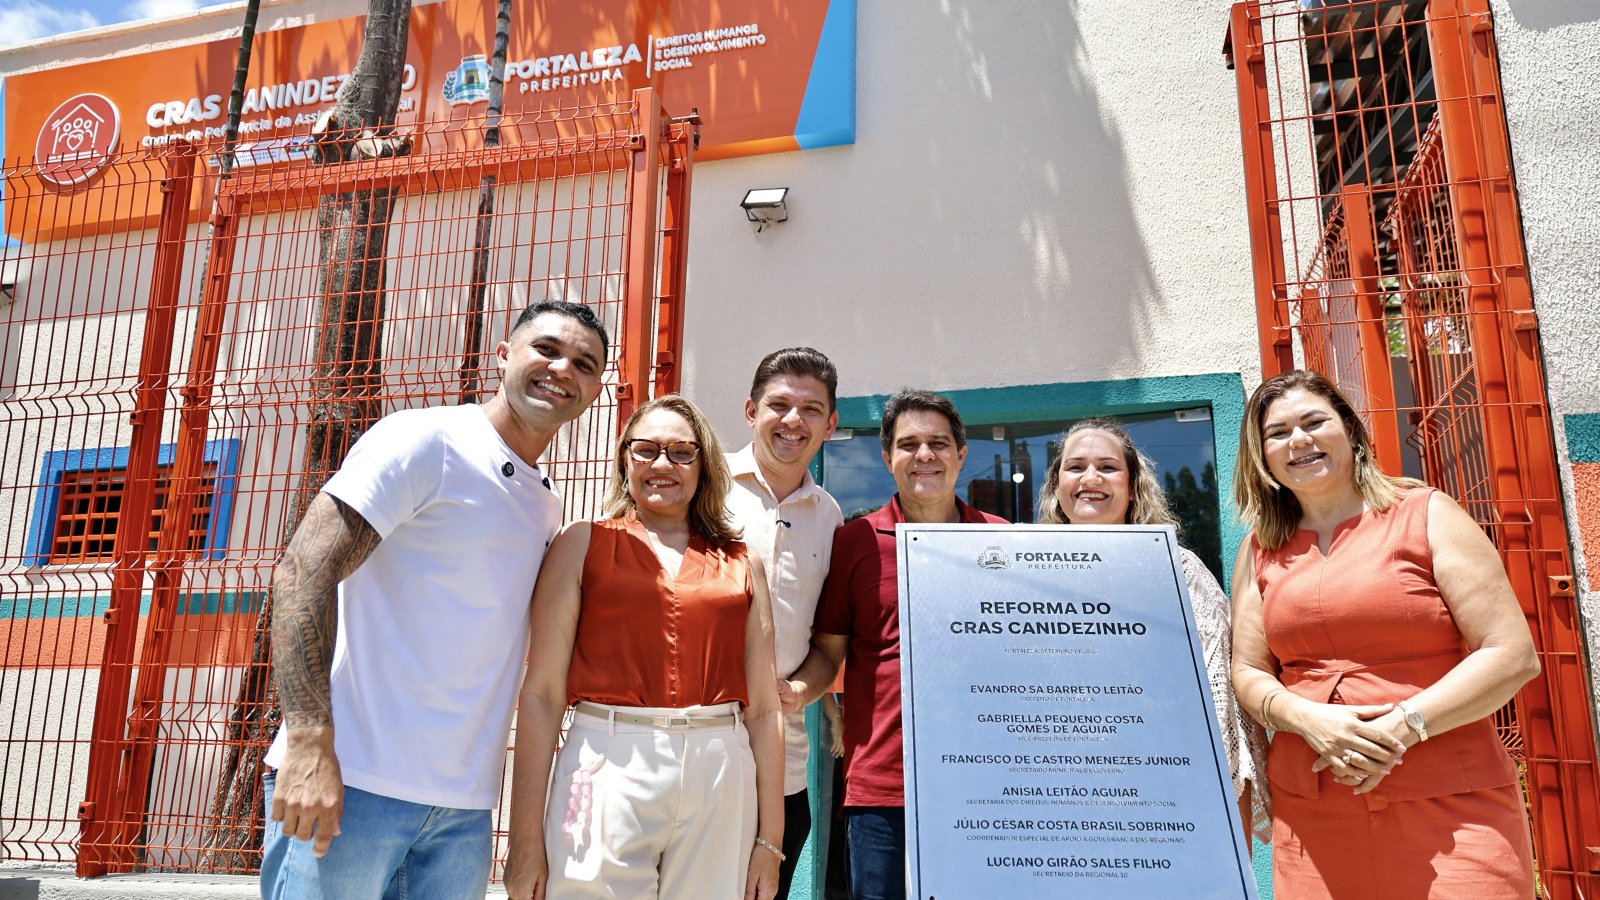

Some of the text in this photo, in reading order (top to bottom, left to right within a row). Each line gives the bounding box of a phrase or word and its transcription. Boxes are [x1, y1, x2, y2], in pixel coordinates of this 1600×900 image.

[656, 24, 758, 48] DIREITOS HUMANOS
[655, 34, 766, 59] E DESENVOLVIMENTO
[504, 43, 642, 82] FORTALEZA
[654, 57, 692, 71] SOCIAL
[520, 68, 623, 94] PREFEITURA
[146, 64, 416, 128] CRAS ANINDEZO
[186, 129, 202, 142] de
[275, 116, 292, 127] da
[1016, 552, 1102, 562] FORTALEZA
[980, 602, 1111, 615] REFORMA DO
[950, 621, 1146, 636] CRAS CANIDEZINHO
[970, 683, 1143, 695] EVANDRO SÁ BARRETO LEITÃO
[977, 714, 1144, 725] GABRIELLA PEQUENO COSTA
[1007, 724, 1117, 734] GOMES DE AGUIAR
[942, 754, 1191, 766] FRANCISCO DE CASTRO MENEZES JÚNIOR
[1002, 785, 1138, 798] ANÍSIA LEITÃO AGUIAR
[953, 817, 1195, 832] JÚLIO CÉSAR COSTA BRASIL SOBRINHO
[987, 856, 1171, 869] LUCIANO GIRÃO SALES FILHO
